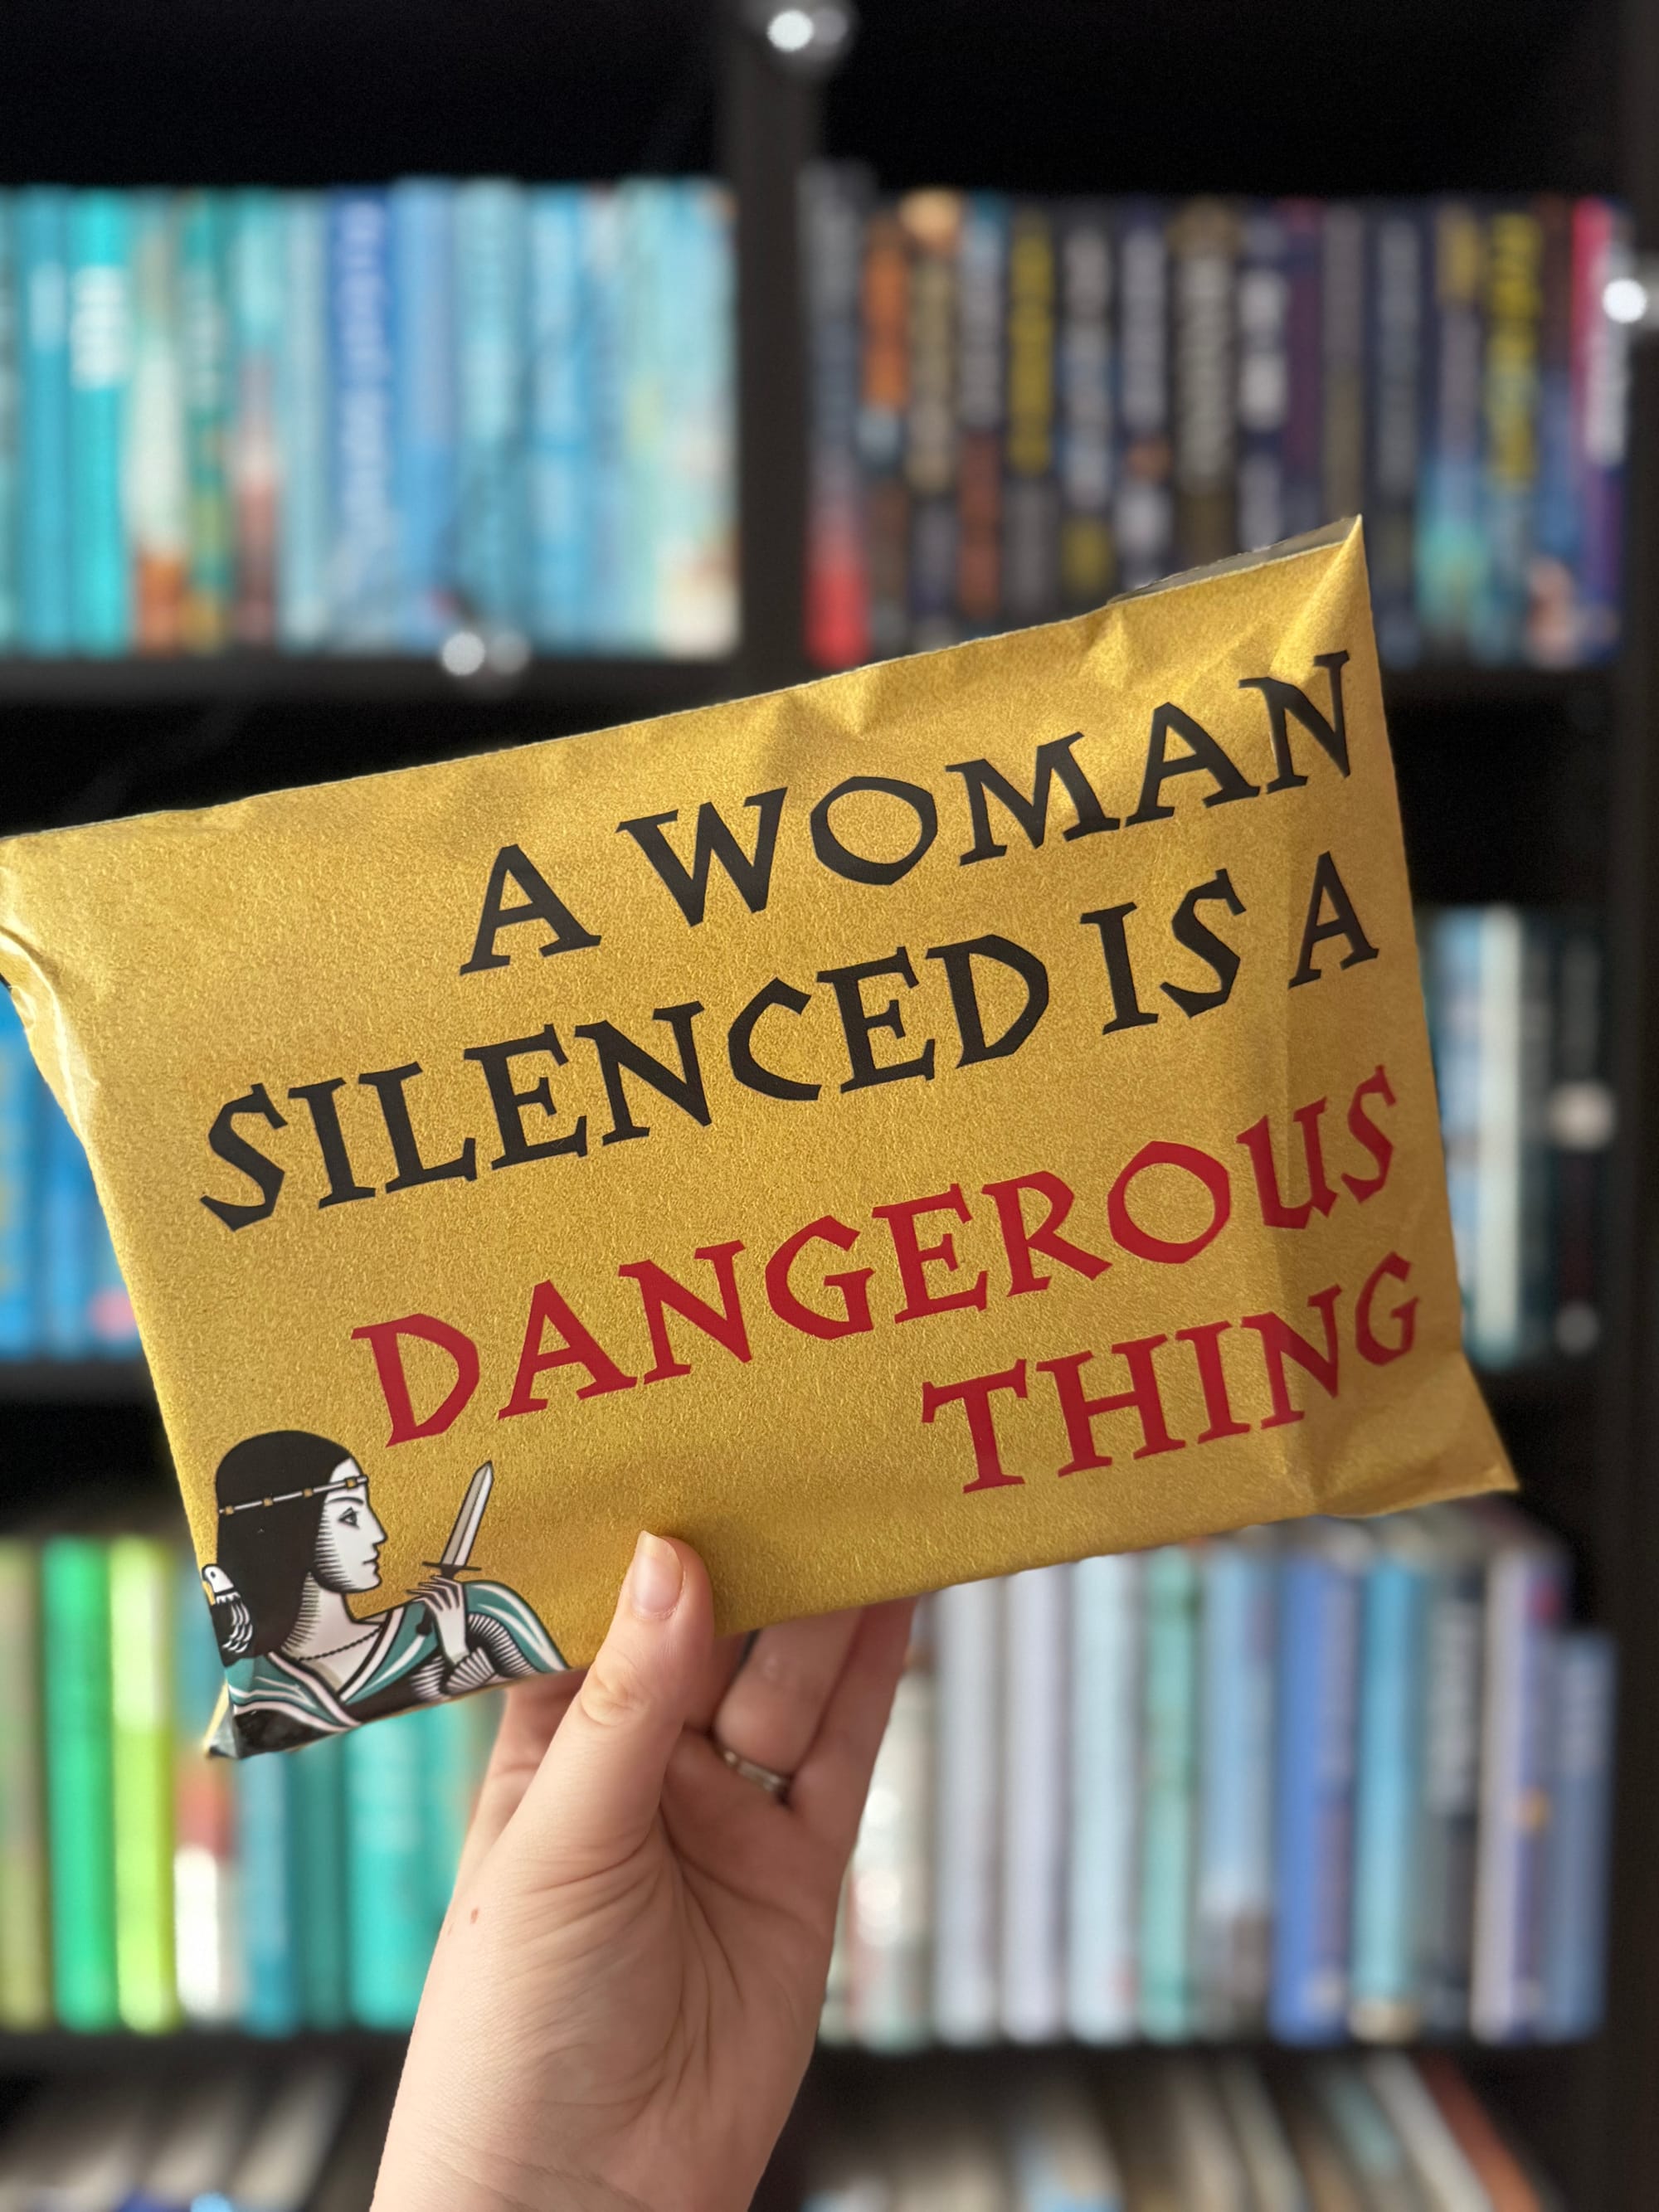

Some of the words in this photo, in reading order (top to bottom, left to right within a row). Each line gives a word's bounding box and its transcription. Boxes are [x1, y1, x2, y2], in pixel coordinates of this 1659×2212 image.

[460, 843, 602, 976] A
[616, 649, 1352, 927] WOMAN
[201, 934, 1050, 1231] SILENCED
[1079, 868, 1248, 1036] IS
[1287, 850, 1380, 990] A
[351, 1064, 1397, 1448] DANGEROUS
[922, 1252, 1419, 1494] THING
